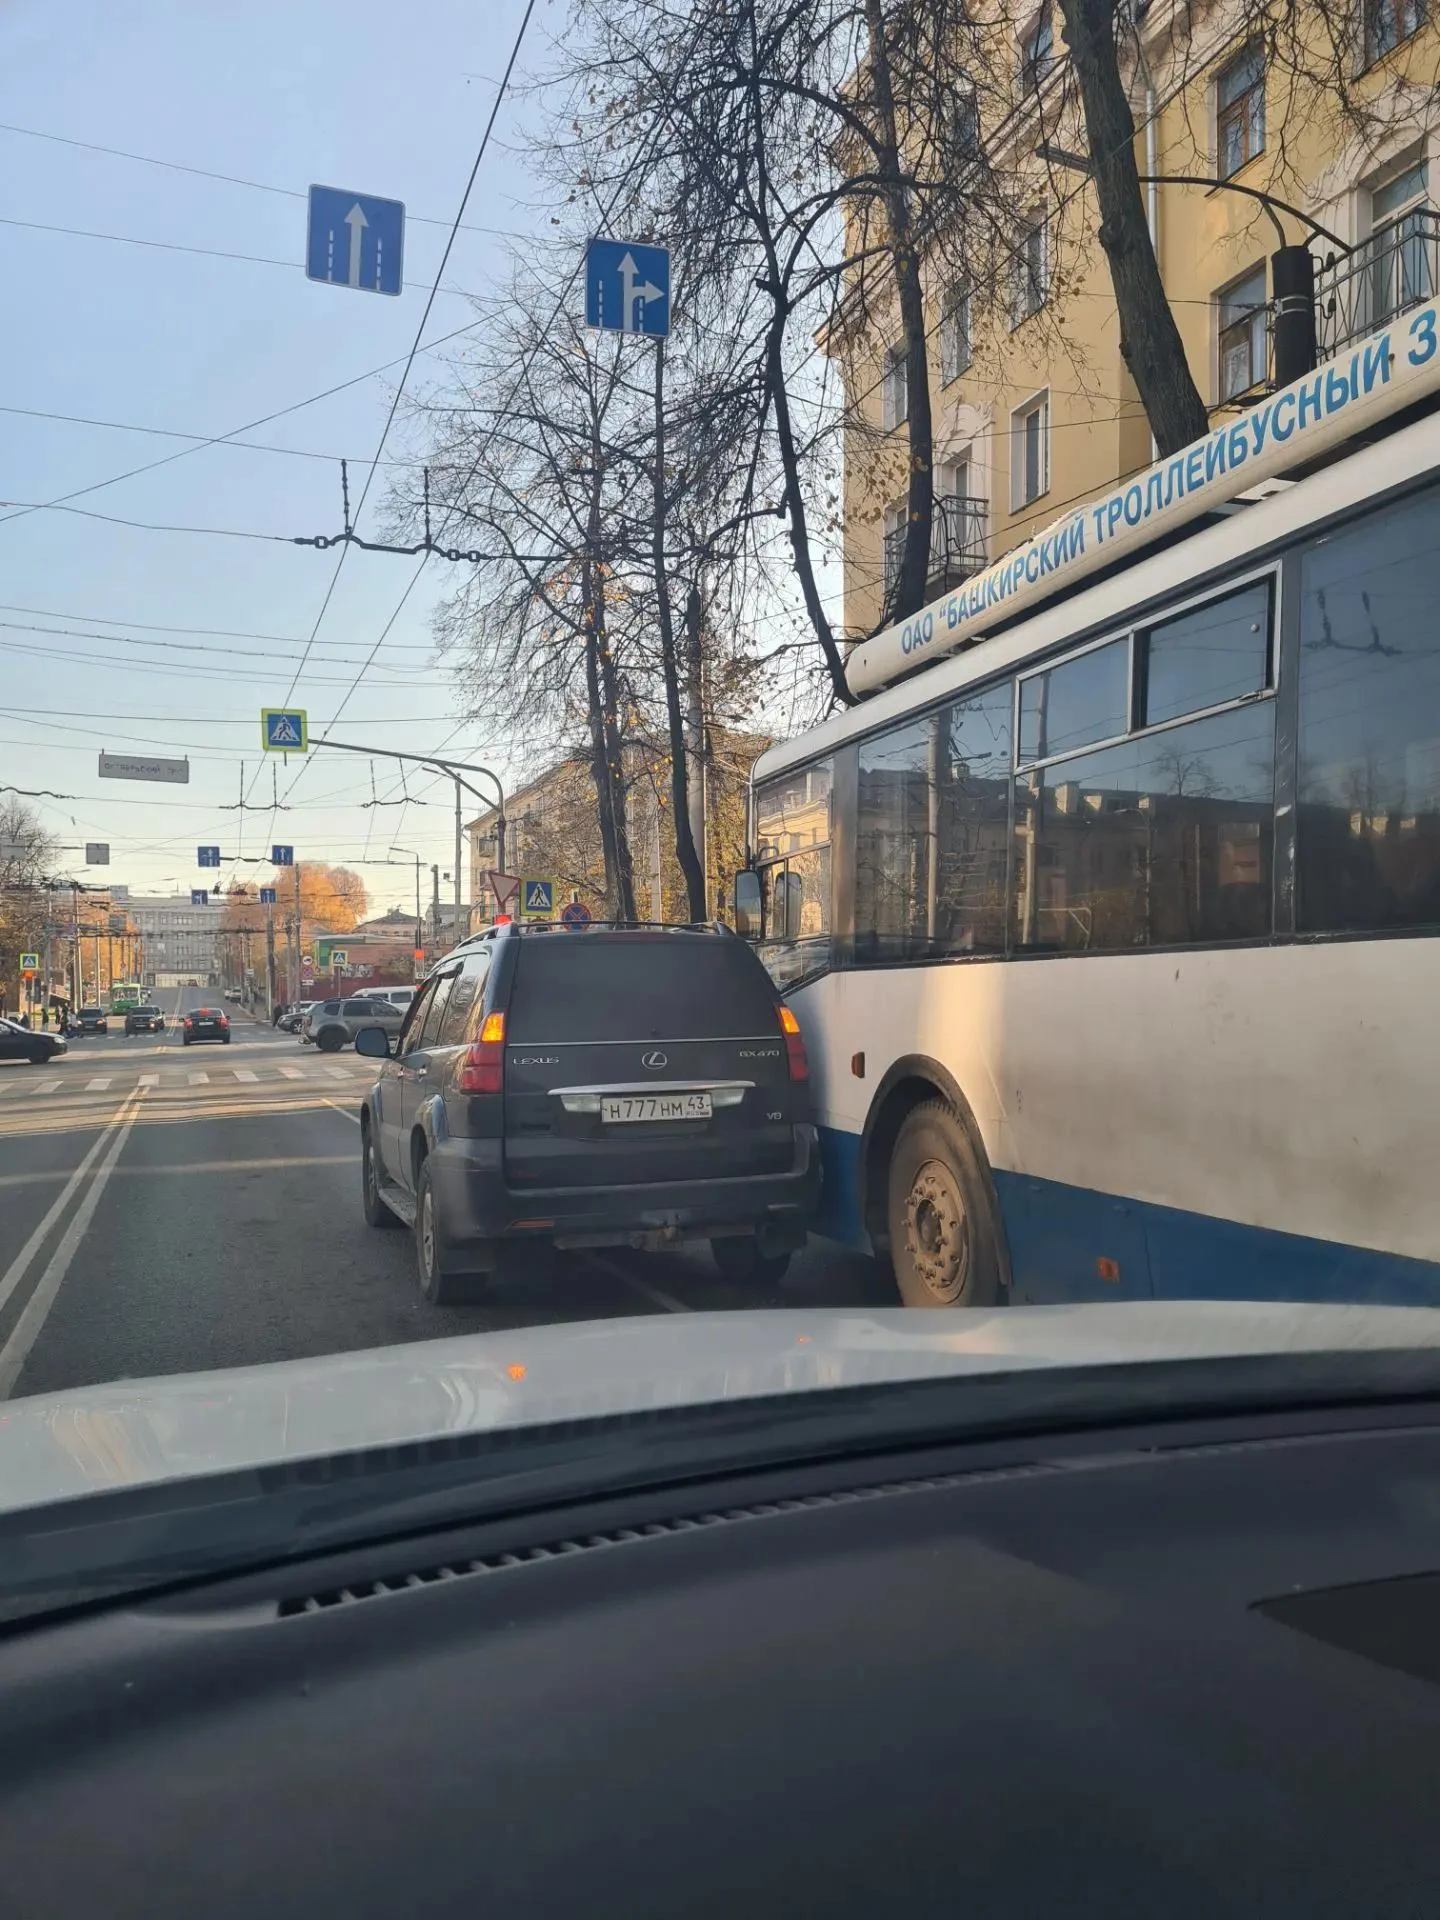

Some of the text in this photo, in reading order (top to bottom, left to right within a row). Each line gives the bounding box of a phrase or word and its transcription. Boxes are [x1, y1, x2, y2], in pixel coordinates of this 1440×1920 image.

[902, 611, 934, 655] ОАО
[1093, 331, 1392, 545] ТРОЛЛЕЙБУСНЫЙ
[513, 1056, 560, 1066] LEXUS
[766, 1111, 783, 1121] V8
